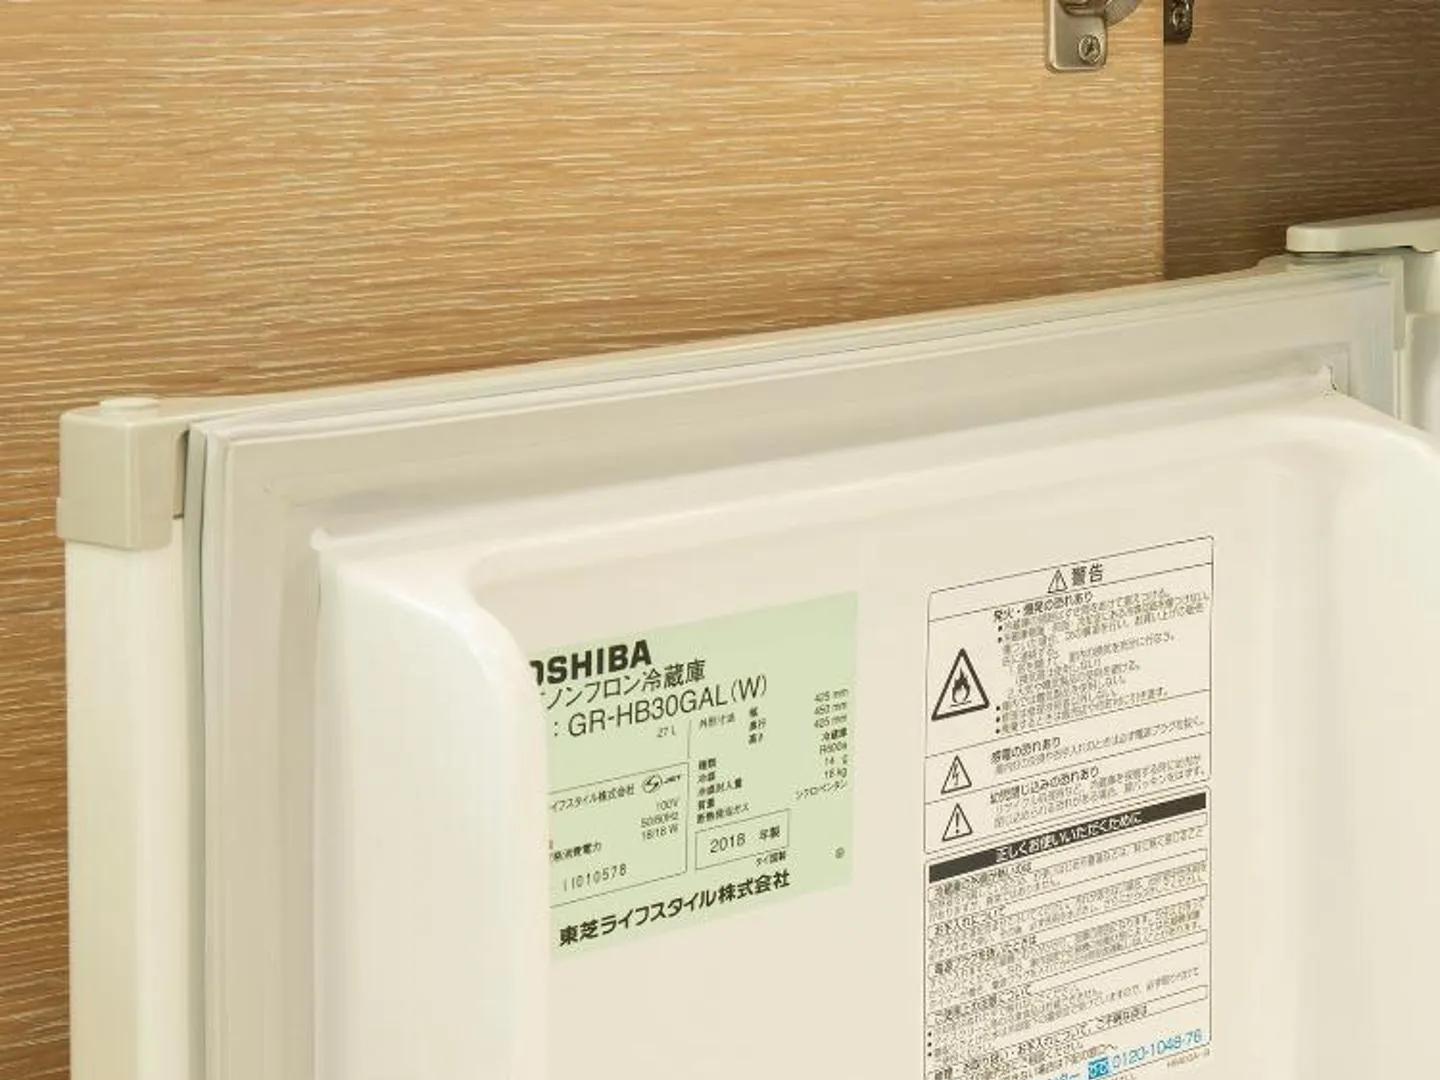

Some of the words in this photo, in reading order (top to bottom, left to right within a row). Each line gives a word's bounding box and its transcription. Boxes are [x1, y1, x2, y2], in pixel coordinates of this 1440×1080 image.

[1071, 563, 1103, 586] 警告
[529, 639, 652, 686] SHIBA
[541, 659, 706, 709] ノンフロン冷蔵庫
[568, 675, 767, 737] GR-HB30GAL(W)
[550, 784, 635, 812] イフスタイル株式会社
[559, 868, 791, 947] 東芝ライフスタイル株式会社
